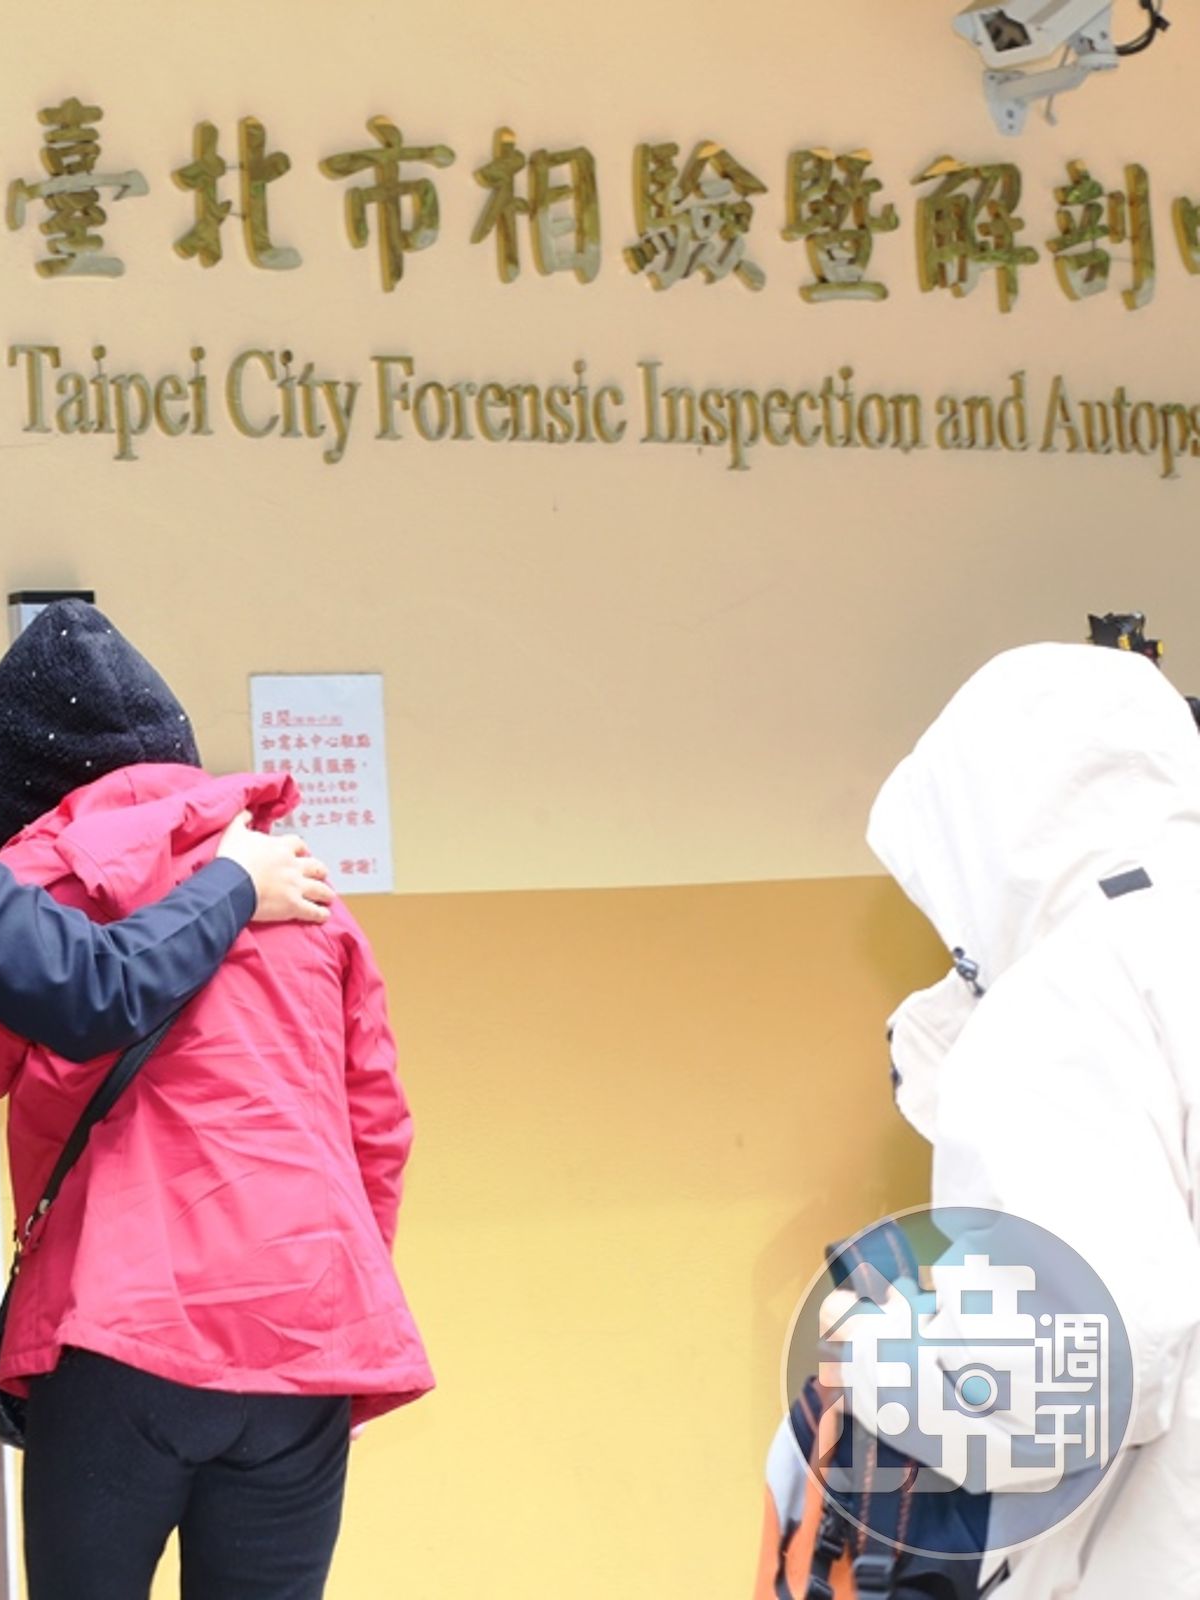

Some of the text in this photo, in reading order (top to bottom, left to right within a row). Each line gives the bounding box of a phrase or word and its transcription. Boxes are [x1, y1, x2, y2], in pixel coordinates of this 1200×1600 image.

[7, 344, 214, 461] Taipei
[225, 348, 362, 464] City
[370, 354, 627, 444] Forensic
[636, 361, 928, 471] Inspection
[935, 370, 1030, 452] and
